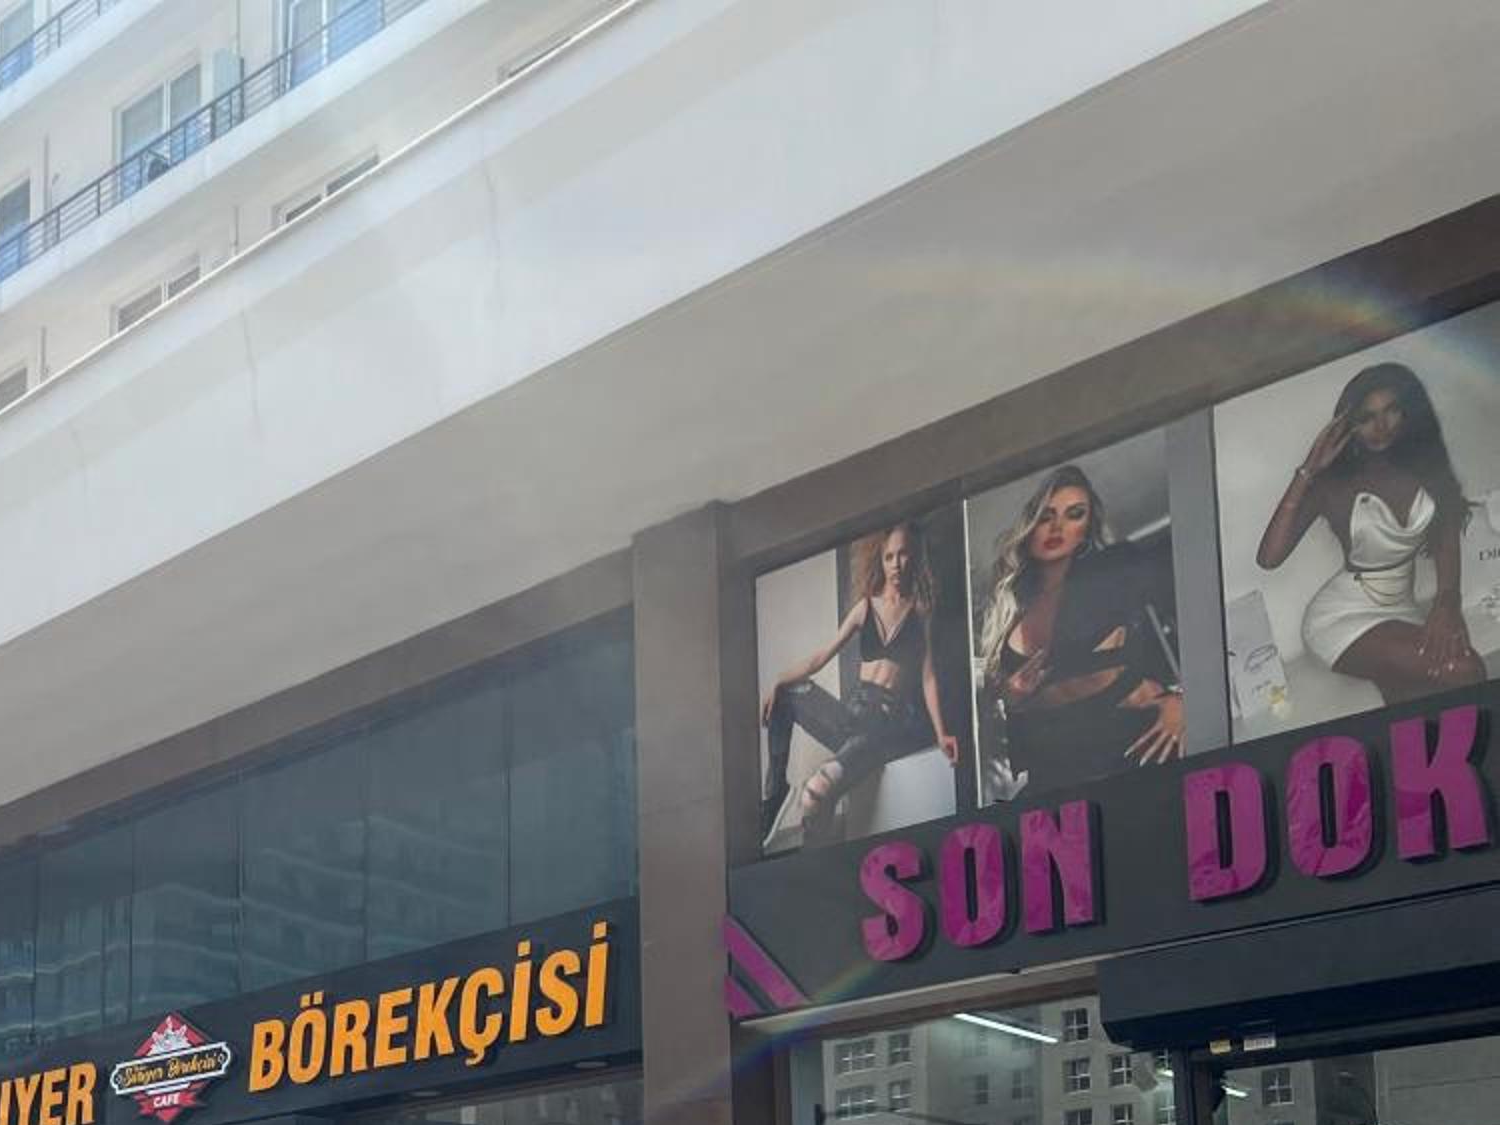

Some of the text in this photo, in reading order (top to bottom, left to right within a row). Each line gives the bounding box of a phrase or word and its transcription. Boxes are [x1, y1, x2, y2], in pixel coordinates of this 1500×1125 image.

[859, 706, 1489, 962] SON DOK
[249, 922, 611, 1094] BÖREKÇİSİ
[153, 1093, 181, 1108] CAFE
